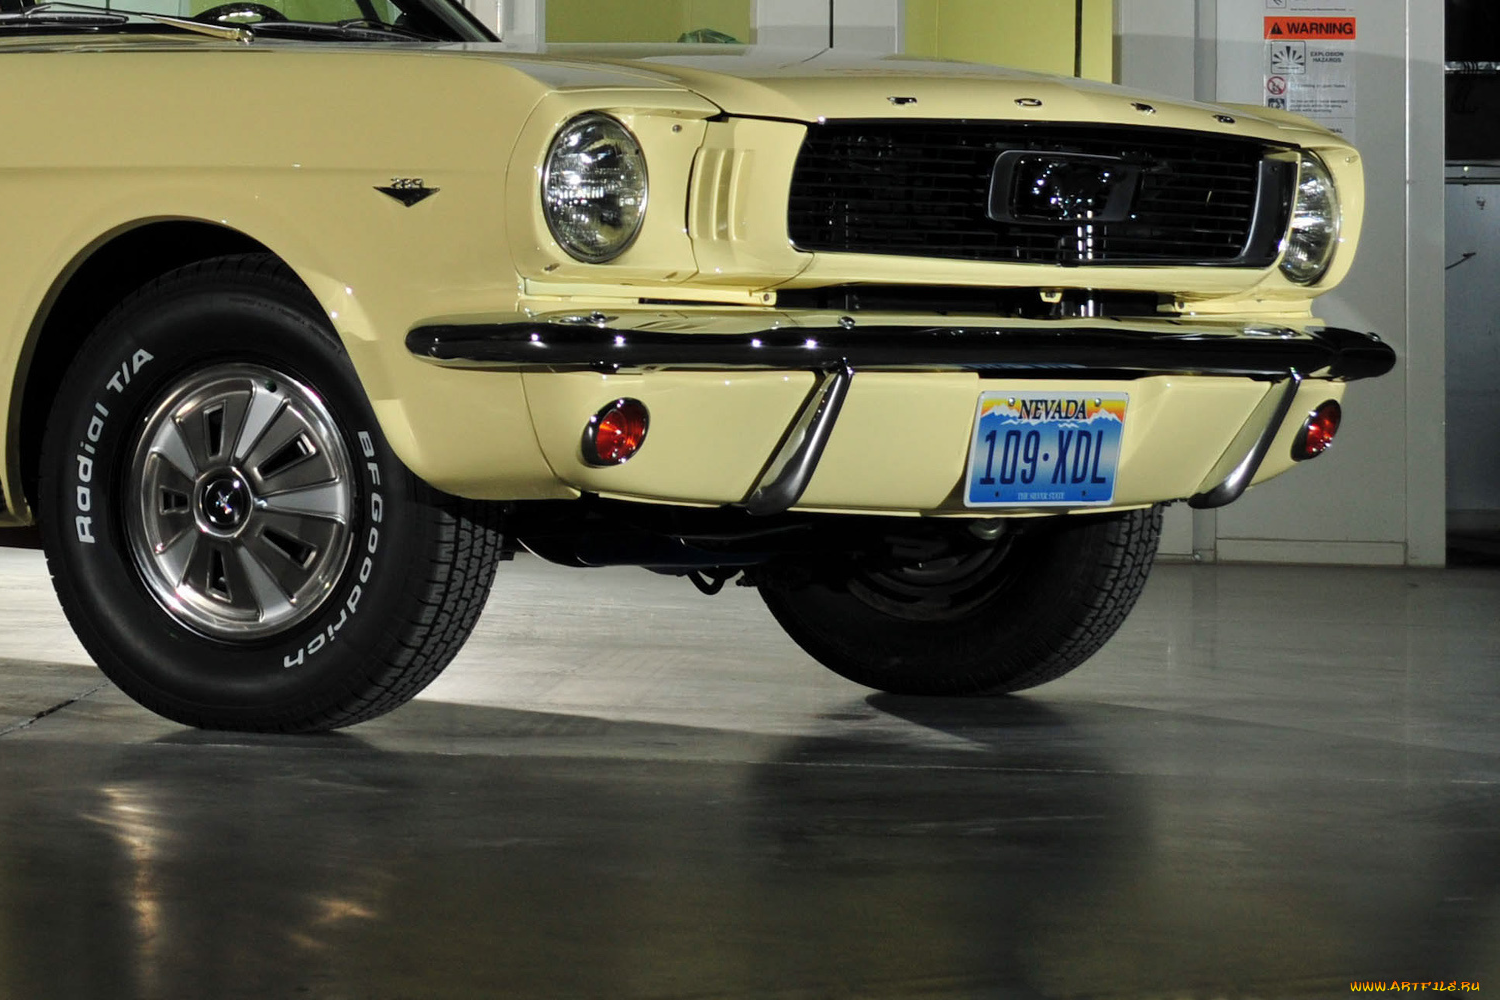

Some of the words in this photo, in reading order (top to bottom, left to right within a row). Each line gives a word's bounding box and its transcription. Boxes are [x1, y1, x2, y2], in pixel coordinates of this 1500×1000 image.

[1287, 22, 1354, 35] WARNING
[74, 401, 110, 545] Radial
[105, 348, 155, 394] T/A
[1017, 399, 1088, 420] NEVADA
[283, 430, 384, 669] BFGoodrich
